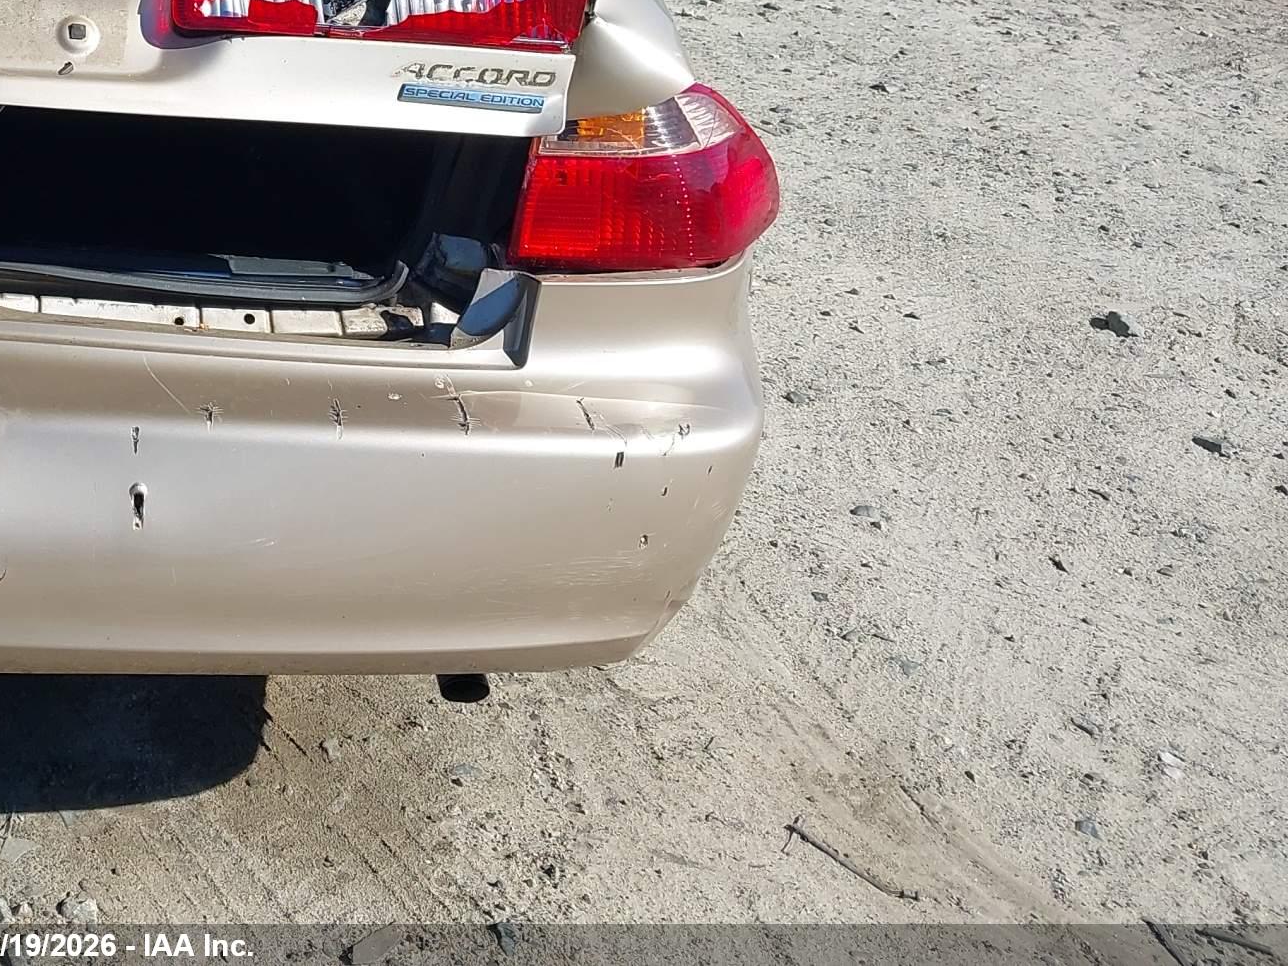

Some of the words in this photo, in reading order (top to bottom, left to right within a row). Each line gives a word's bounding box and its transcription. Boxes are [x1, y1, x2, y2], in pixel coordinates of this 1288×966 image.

[392, 62, 557, 87] ACCORD
[403, 87, 476, 102] SPECIAL
[480, 93, 545, 108] EDITION
